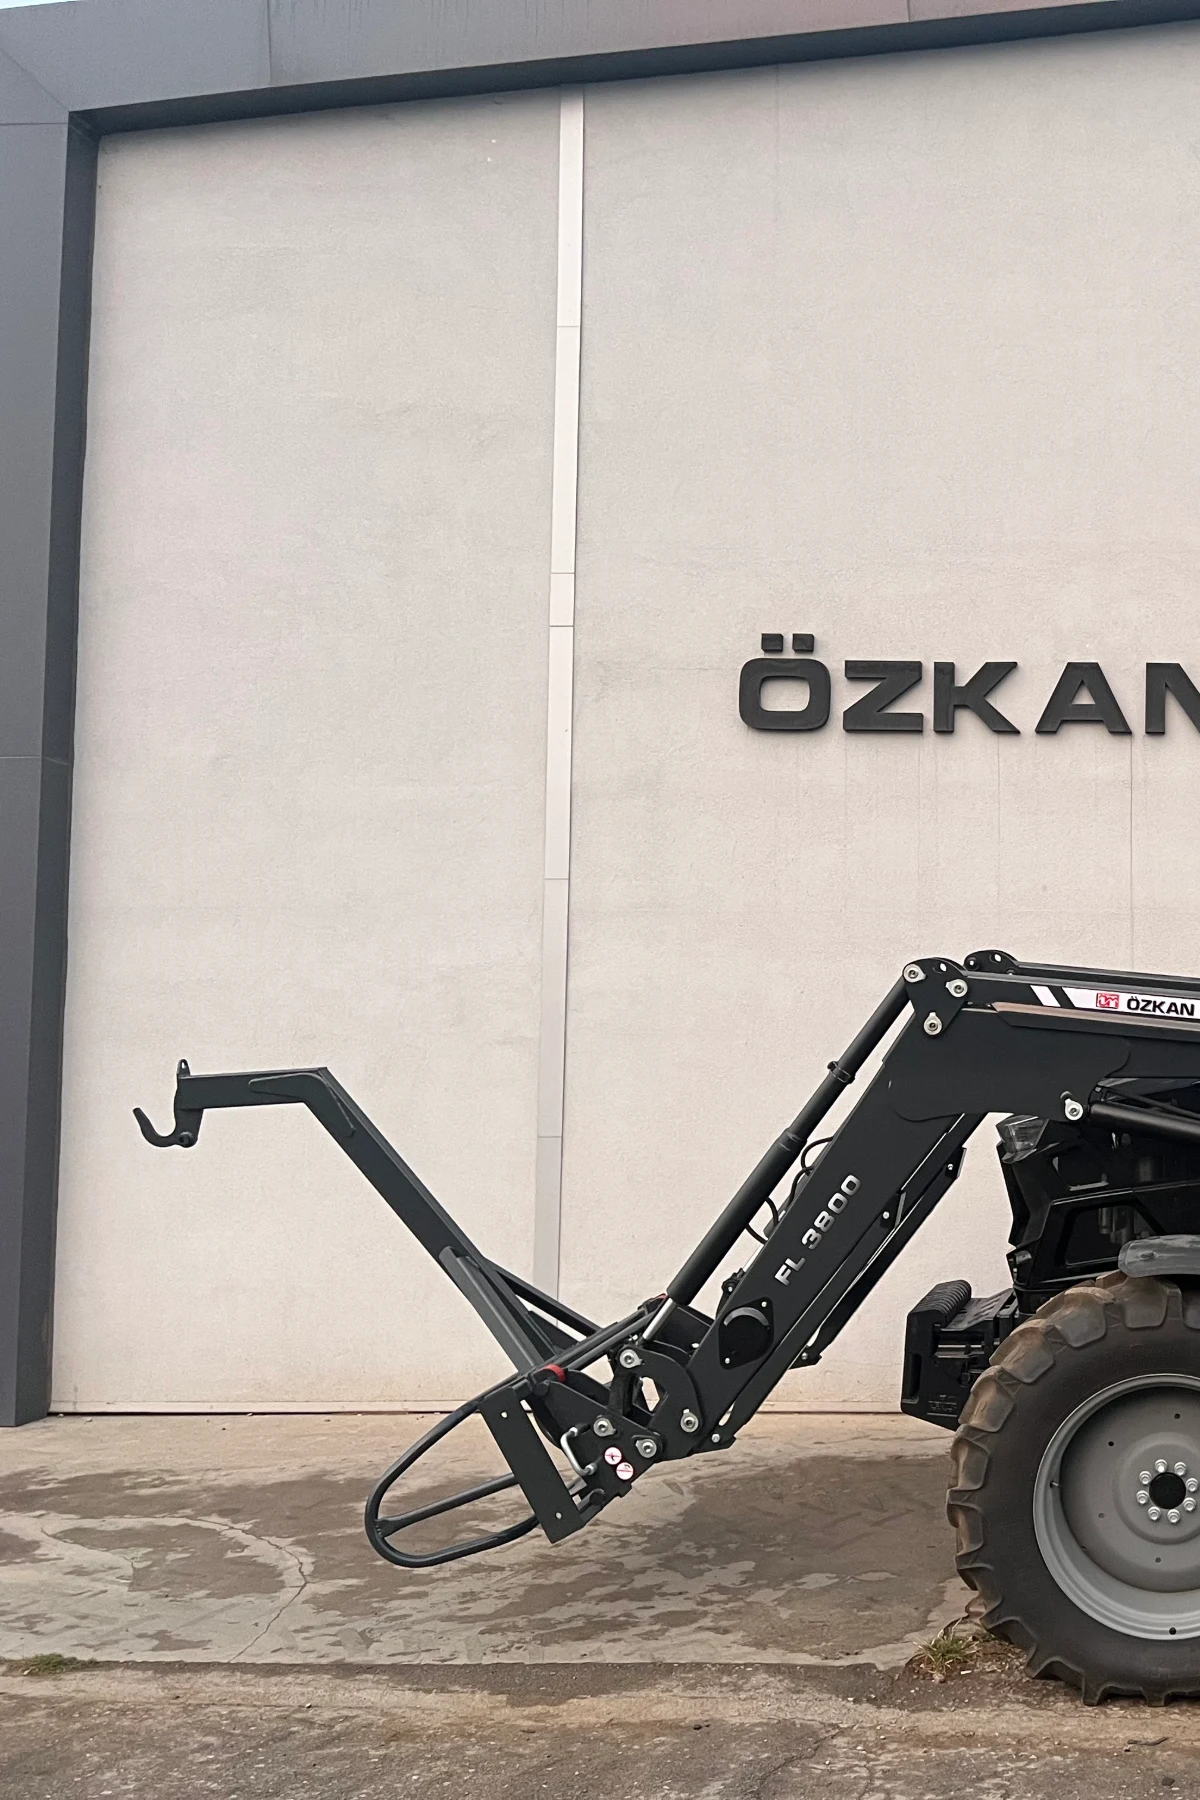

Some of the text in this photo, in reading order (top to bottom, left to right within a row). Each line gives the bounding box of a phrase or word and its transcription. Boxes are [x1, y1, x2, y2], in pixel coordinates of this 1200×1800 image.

[1126, 996, 1195, 1017] ÖZKAN
[774, 1174, 861, 1286] FL 3800
